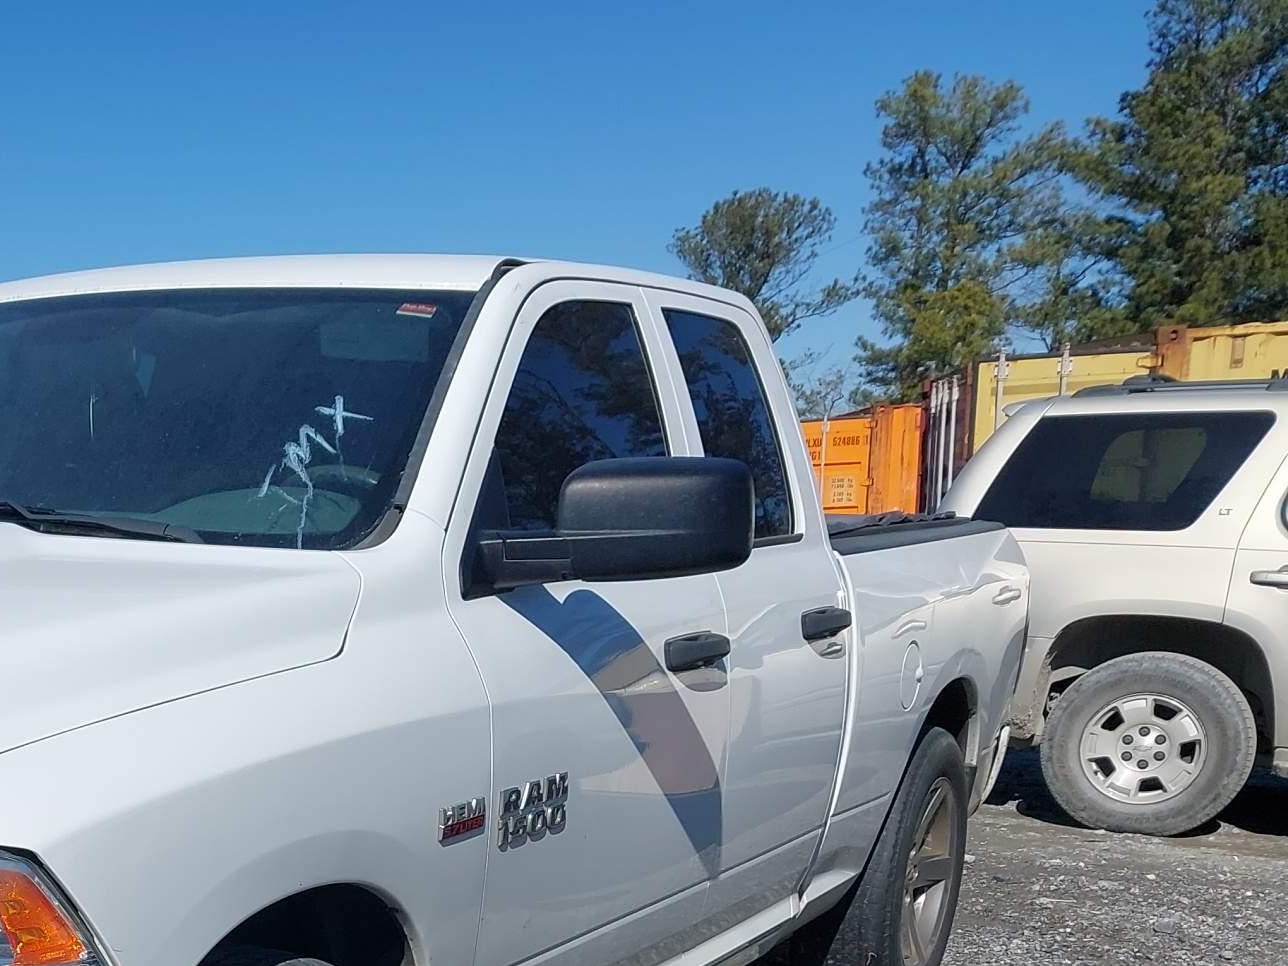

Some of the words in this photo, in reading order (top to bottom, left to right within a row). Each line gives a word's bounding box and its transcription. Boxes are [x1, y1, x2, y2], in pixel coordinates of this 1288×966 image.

[1218, 508, 1233, 516] LT
[439, 797, 486, 827] HEMI
[499, 771, 569, 818] RAM
[497, 804, 567, 852] 1500
